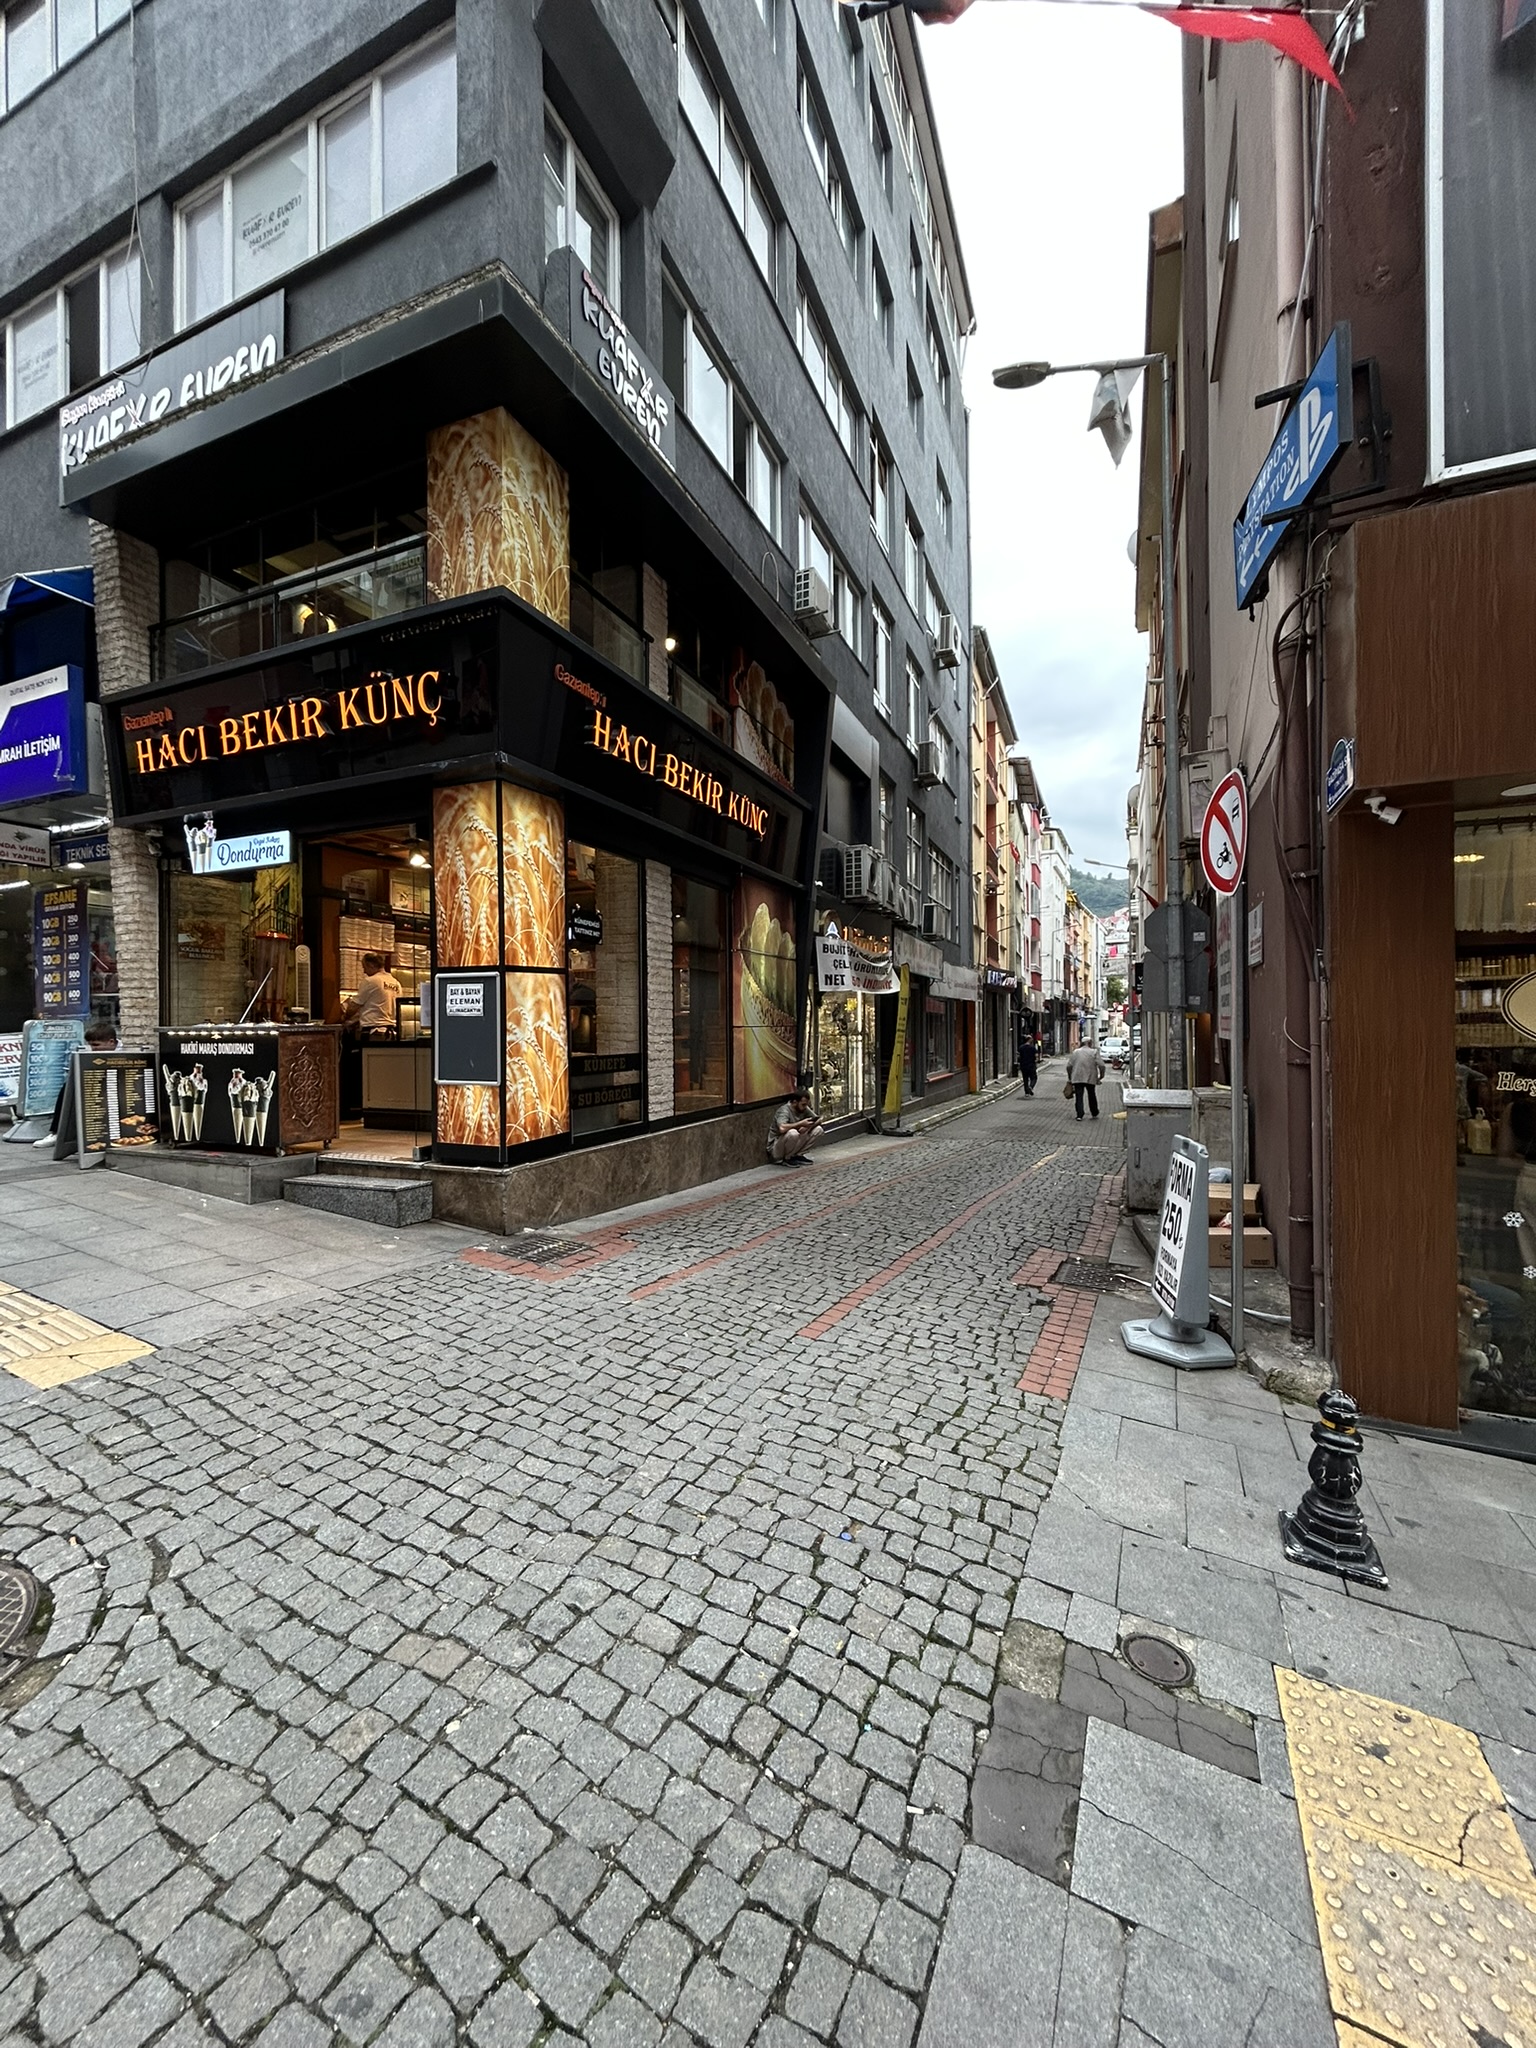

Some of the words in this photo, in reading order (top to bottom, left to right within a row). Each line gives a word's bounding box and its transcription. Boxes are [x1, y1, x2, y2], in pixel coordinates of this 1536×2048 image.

[598, 347, 661, 446] EVREN
[136, 725, 208, 774] HACI
[219, 697, 327, 756] BEKİR
[337, 670, 442, 730] KÜNÇ
[23, 733, 61, 758] İLETİŞİM
[593, 709, 657, 776] HACI
[663, 753, 723, 814] BEKİR
[727, 791, 769, 843] KÜNÇ
[65, 843, 95, 862] TEKNİK
[217, 841, 284, 866] Dondurma
[43, 888, 78, 907] EFSANE
[42, 935, 60, 947] 20GB
[43, 972, 62, 984] 60GB
[824, 974, 846, 986] NET
[43, 991, 62, 1003] 90GB
[450, 988, 460, 996] BAY
[465, 988, 481, 996] BAYAN
[198, 1042, 218, 1056] MARAŞ
[218, 1042, 255, 1055] DONDURMASI
[583, 1056, 626, 1072] KÜNEFE
[577, 1092, 593, 1106] SU
[1170, 1157, 1194, 1203] FORMA
